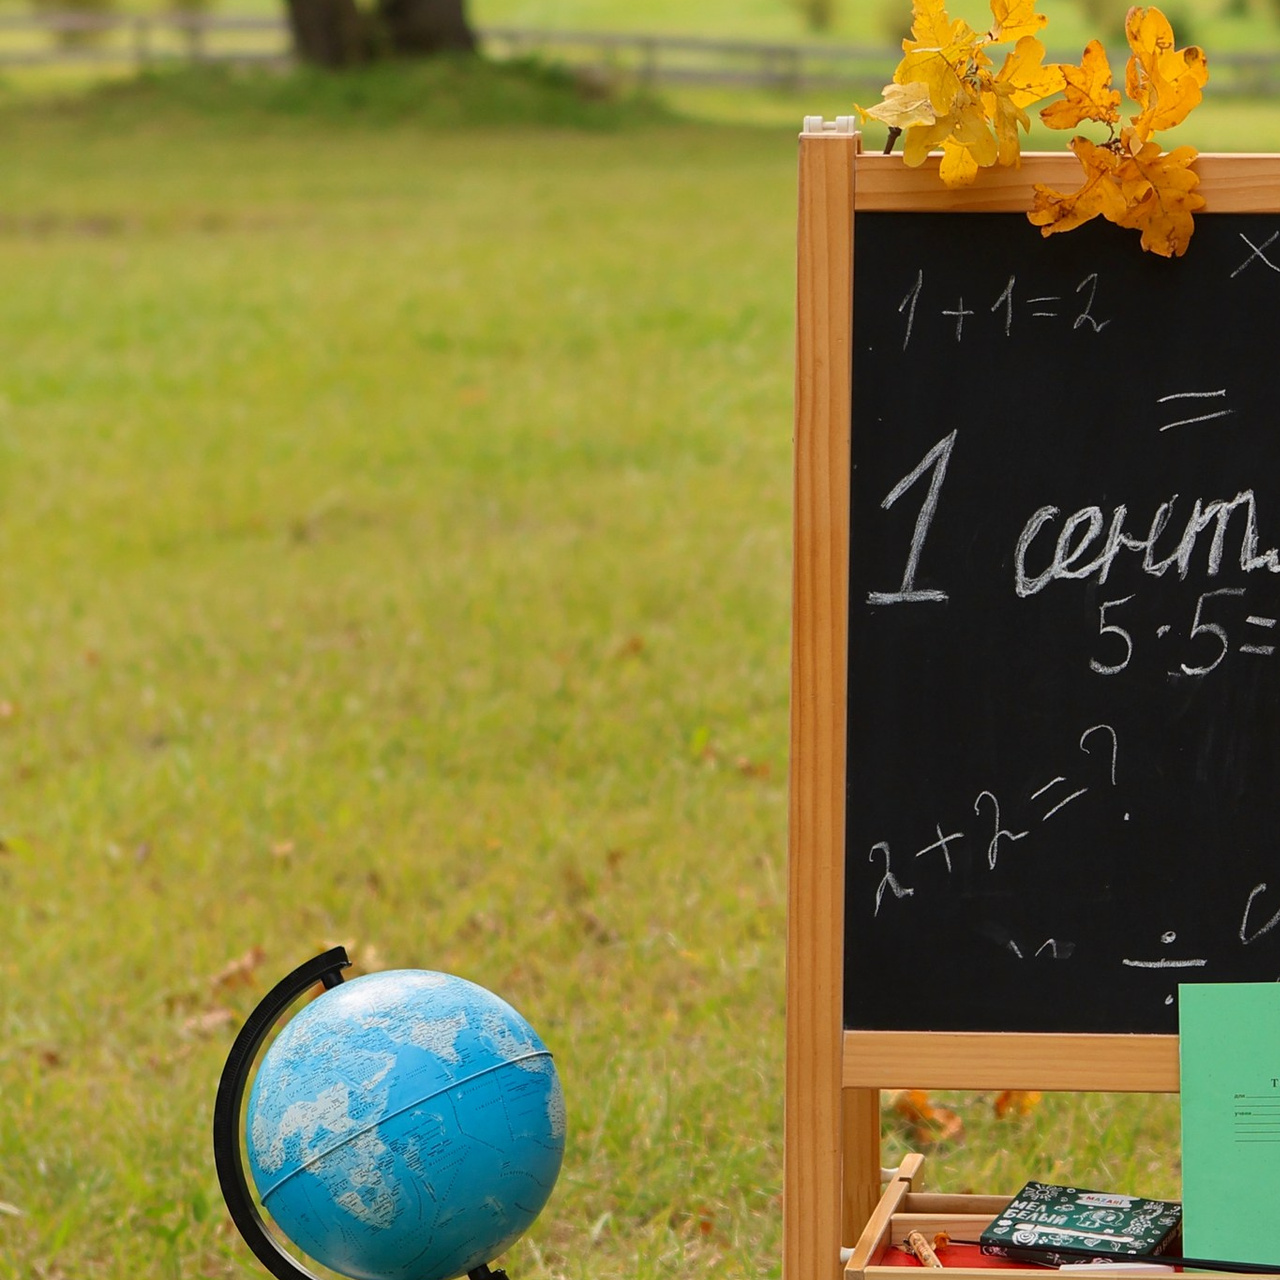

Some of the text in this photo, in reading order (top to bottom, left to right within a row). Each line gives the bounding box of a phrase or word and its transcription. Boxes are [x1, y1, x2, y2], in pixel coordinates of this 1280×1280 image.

[866, 428, 959, 604] 1
[1011, 1200, 1046, 1214] МЕЛ
[1002, 1208, 1069, 1225] БЕЛЫЙ
